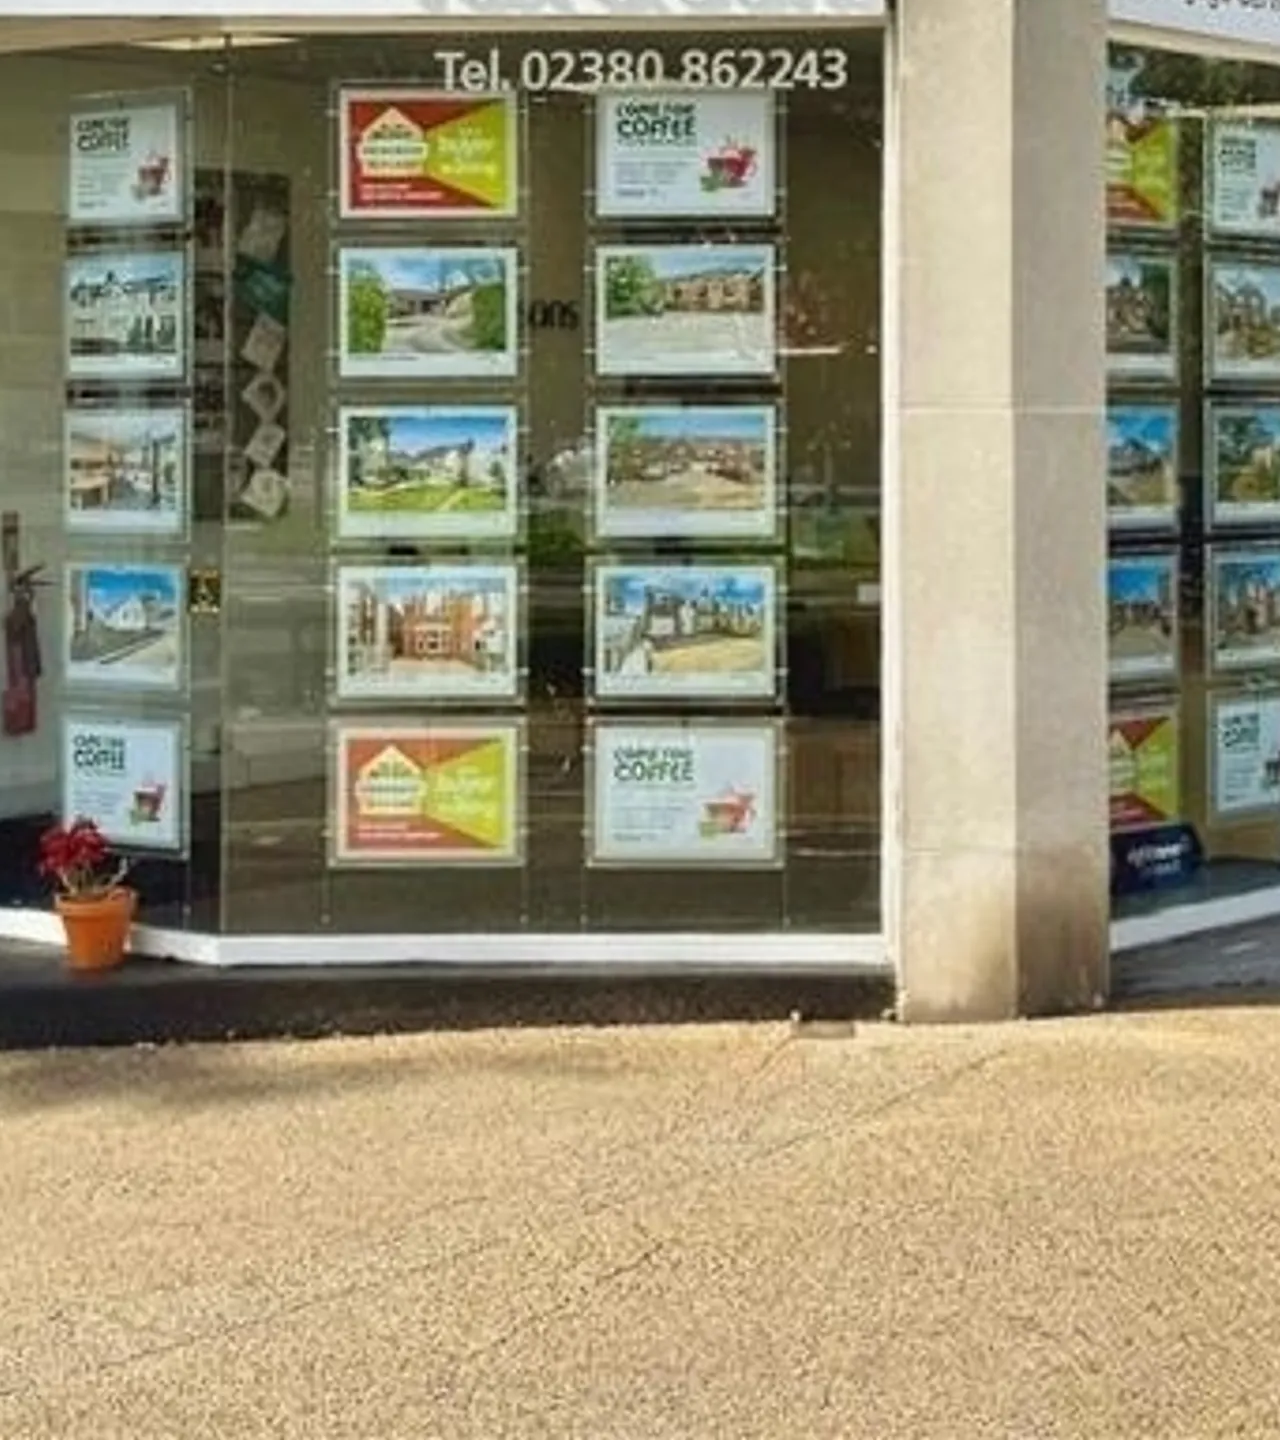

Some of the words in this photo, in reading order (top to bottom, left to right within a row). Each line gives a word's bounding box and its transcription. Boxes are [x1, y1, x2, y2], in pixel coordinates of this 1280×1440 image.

[434, 49, 511, 90] Tel.
[521, 49, 663, 91] 02380
[681, 49, 848, 90] 862243
[527, 298, 580, 332] ons
